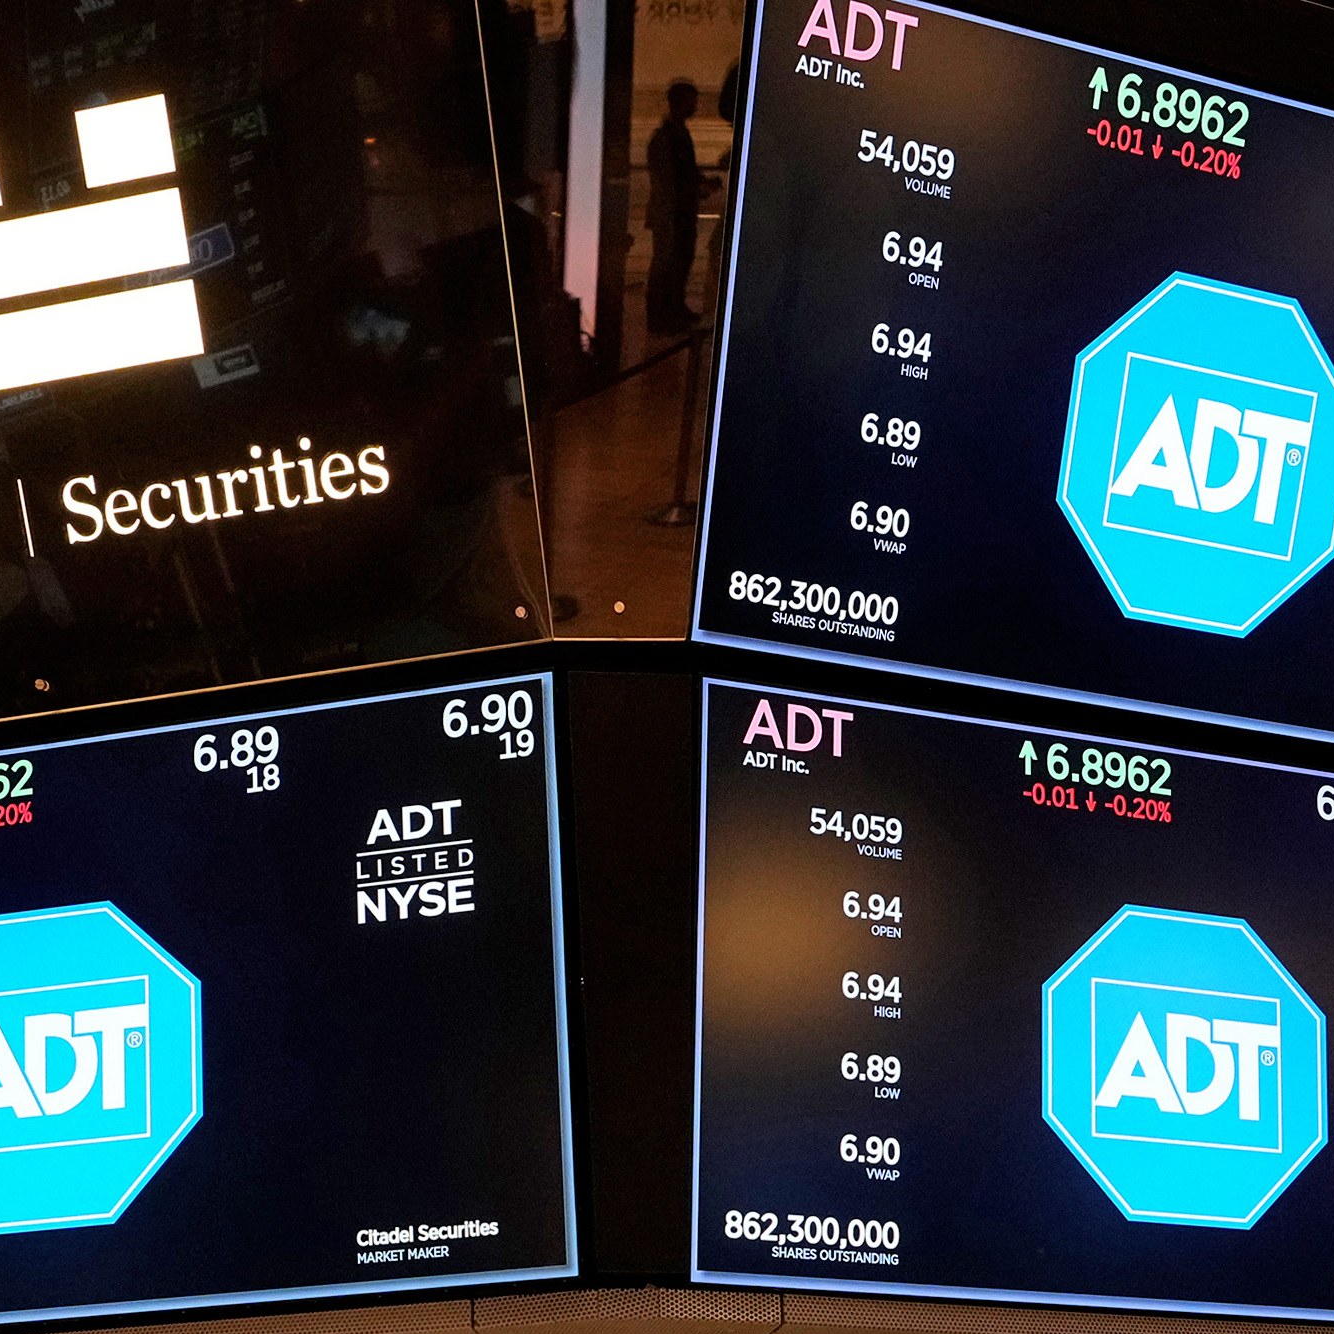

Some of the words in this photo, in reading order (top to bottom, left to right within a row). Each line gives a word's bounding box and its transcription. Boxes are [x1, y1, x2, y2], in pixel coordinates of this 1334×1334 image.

[796, 0, 921, 72] ADT
[795, 55, 833, 79] ADT
[836, 64, 864, 88] Inc.
[1117, 72, 1250, 149] 6.8962
[858, 130, 954, 180] 54,059
[1087, 123, 1144, 155] -0.01
[1172, 144, 1241, 179] -0.20%
[905, 177, 951, 199] VOLUME
[883, 231, 943, 272] 6.94
[909, 272, 939, 289] OPEN
[872, 323, 931, 362] 6.94
[901, 363, 928, 380] HIGH
[861, 413, 920, 450] 6.89
[891, 453, 917, 468] LOW
[64, 437, 392, 548] Securities
[851, 501, 909, 537] 6.90
[874, 538, 906, 554] VWAP
[729, 571, 898, 626] 862,300,000
[772, 612, 816, 629] SHARES
[818, 617, 897, 642] OUTSTANDING
[443, 690, 534, 740] 6.90
[743, 699, 853, 758] ADT
[194, 726, 279, 775] 6.89
[499, 729, 534, 759] 19
[247, 764, 280, 793] 18
[1047, 742, 1173, 797] 6.8962
[367, 799, 461, 845] ADT
[810, 808, 902, 844] 54,059
[356, 845, 474, 884] LISTED
[357, 877, 475, 924] NYSE
[357, 1226, 414, 1246] Citadel
[418, 1220, 499, 1241] Securities
[725, 1210, 899, 1252] 862,300,000
[357, 1249, 405, 1264] MARKET
[408, 1246, 449, 1260] MAKER
